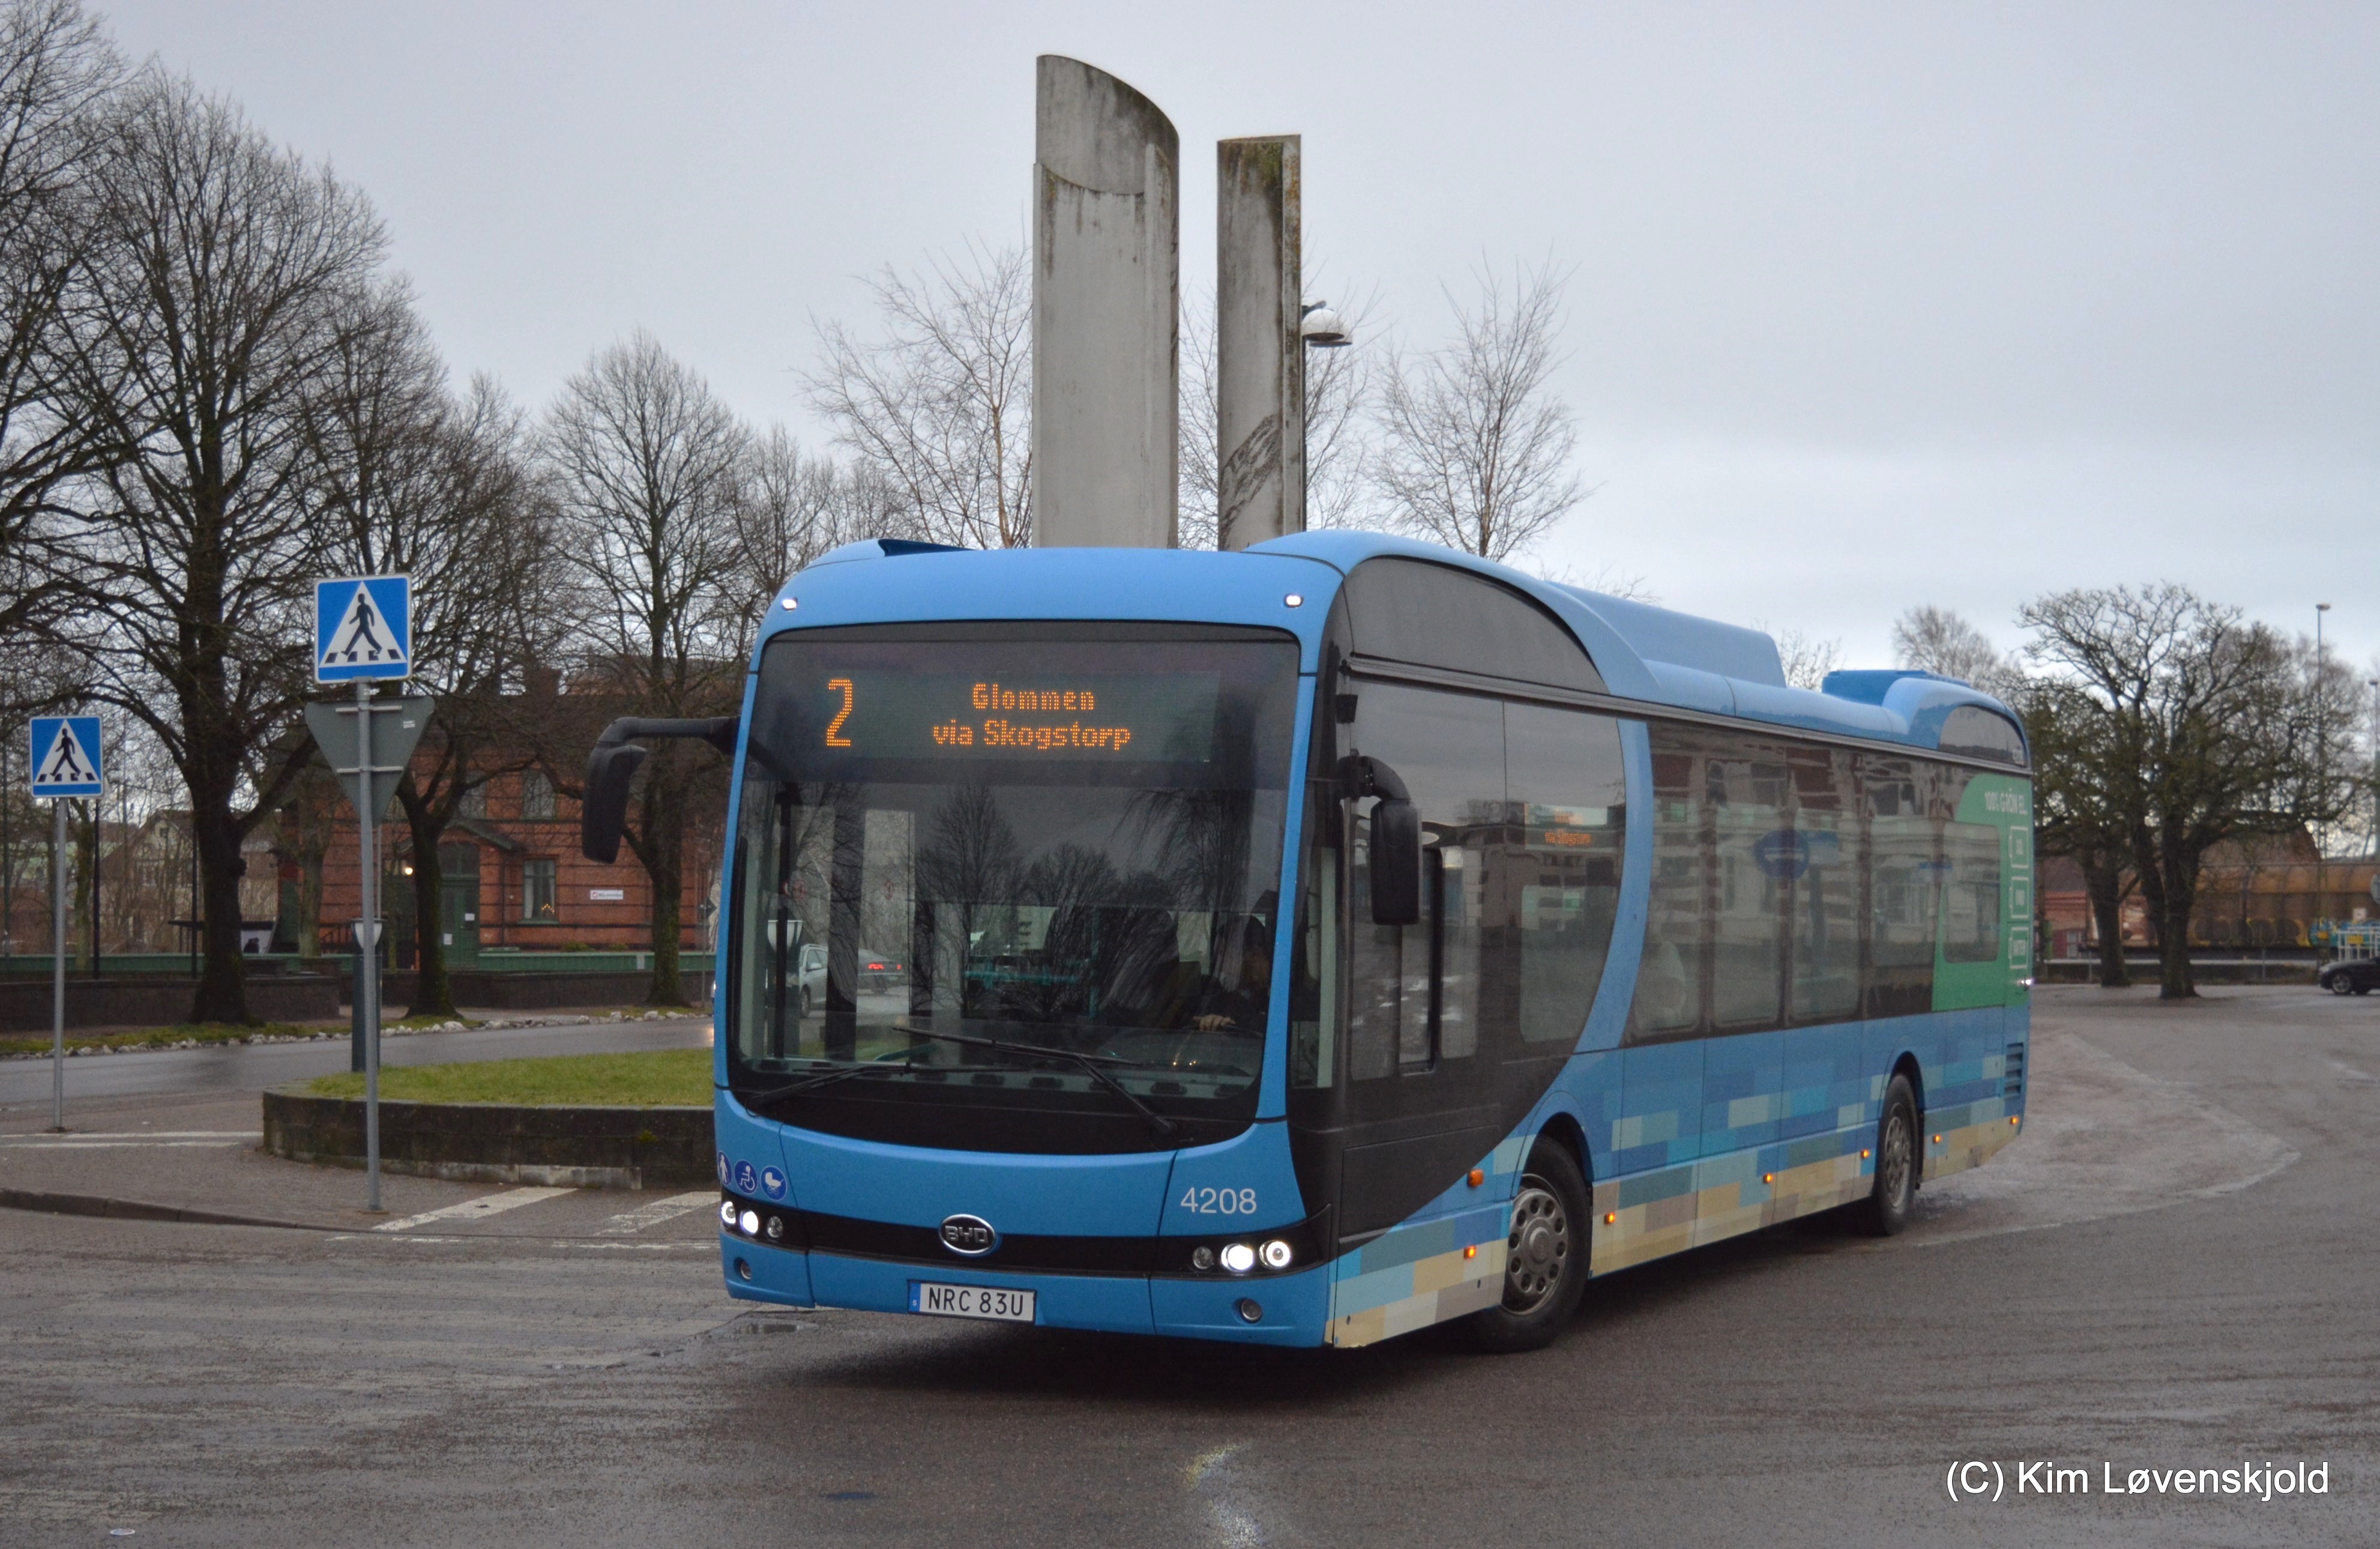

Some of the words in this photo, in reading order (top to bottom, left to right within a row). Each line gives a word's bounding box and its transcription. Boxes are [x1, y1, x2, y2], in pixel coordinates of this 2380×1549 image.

[972, 683, 1095, 711] Glommen
[827, 678, 853, 747] 2
[933, 719, 973, 746] via
[984, 719, 1131, 750] Skogstorp
[1181, 1187, 1258, 1214] 4208
[945, 1225, 989, 1243] BYD
[929, 1287, 971, 1312] NRC
[979, 1291, 1023, 1316] 83U
